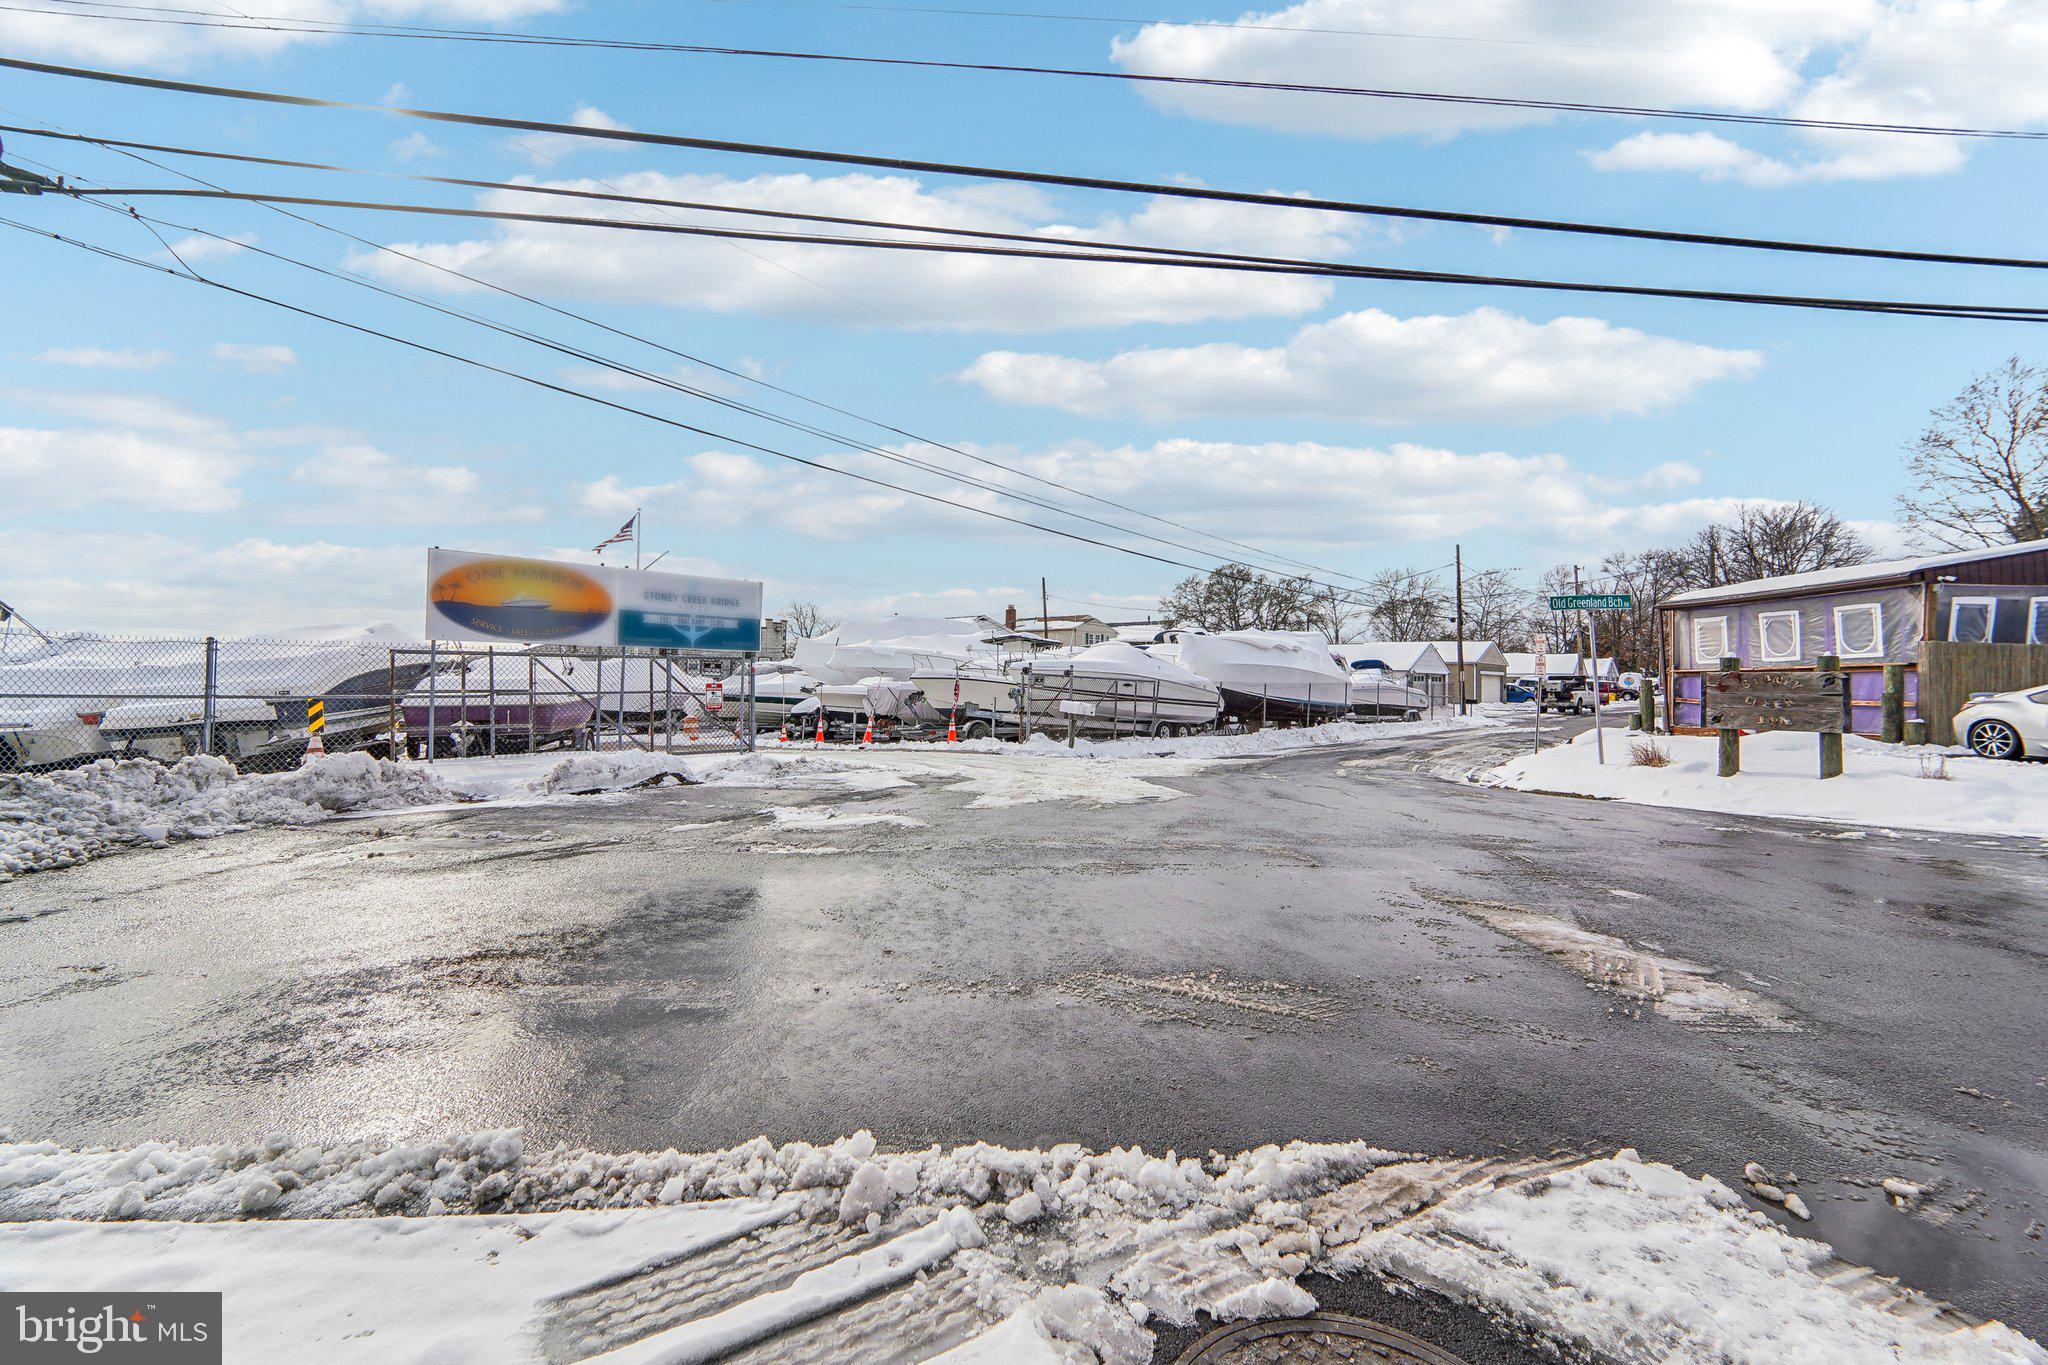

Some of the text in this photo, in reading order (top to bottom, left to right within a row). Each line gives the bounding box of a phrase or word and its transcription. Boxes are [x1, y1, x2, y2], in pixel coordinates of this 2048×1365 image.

[643, 591, 678, 602] STONEY
[682, 594, 709, 604] CREEK
[711, 597, 741, 608] BRIDGE
[1552, 598, 1566, 609] Old
[1567, 597, 1607, 608] Greenland
[1608, 596, 1623, 608] Bch
[471, 617, 504, 632] SERVICE
[511, 627, 533, 636] SALES
